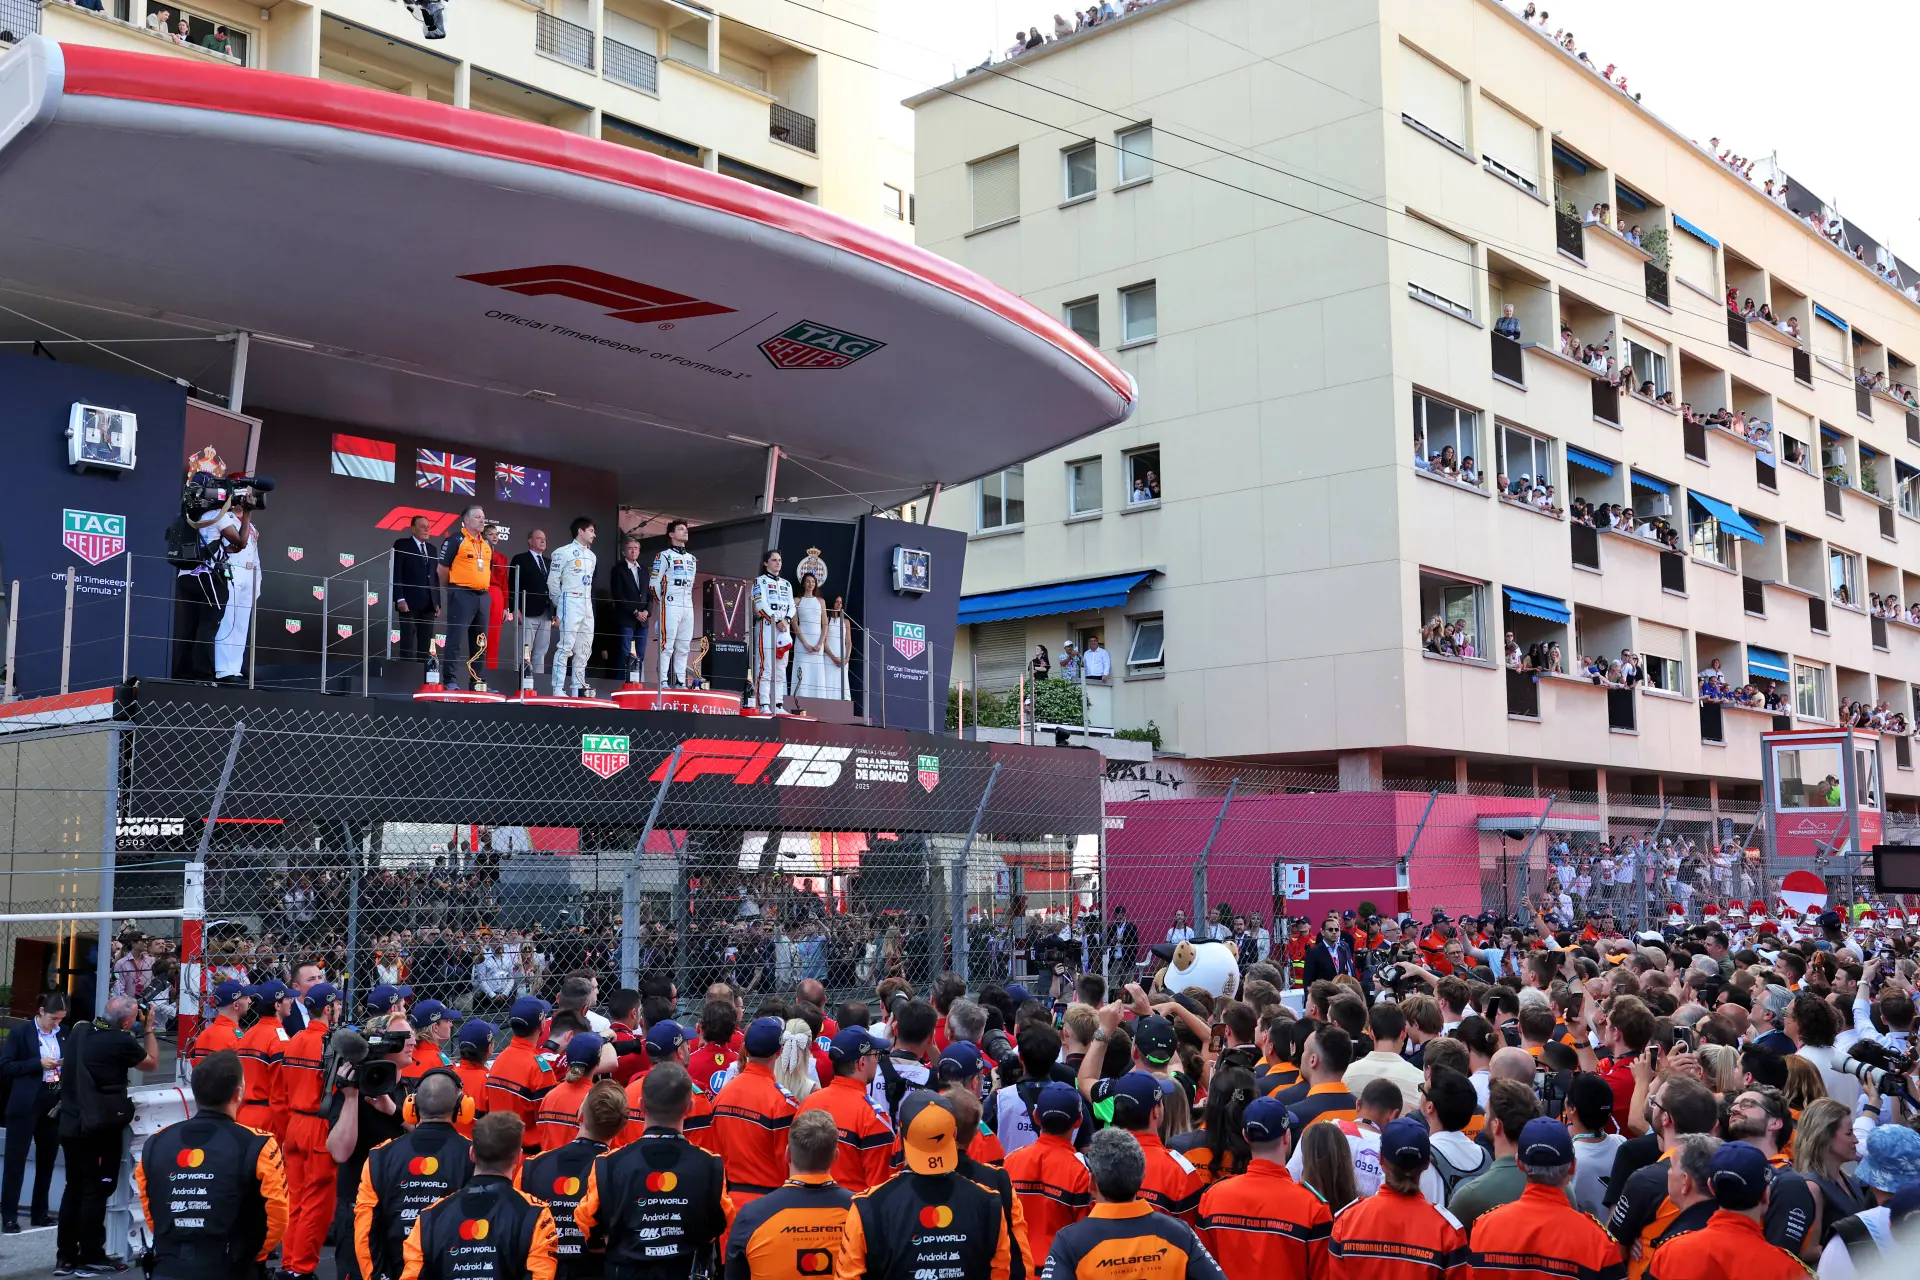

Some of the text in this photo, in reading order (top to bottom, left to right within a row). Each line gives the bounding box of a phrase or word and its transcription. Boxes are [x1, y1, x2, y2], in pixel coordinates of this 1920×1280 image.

[484, 309, 544, 329] Official
[550, 325, 648, 356] Timekeeper
[650, 351, 673, 361] of
[667, 355, 738, 377] Formula
[797, 326, 870, 355] TAG
[768, 340, 848, 366] HEUER
[68, 512, 120, 535] TAG
[66, 533, 122, 562] HEUER
[76, 584, 112, 595] Formula
[896, 624, 922, 638] TAG
[894, 638, 924, 657] HEUER
[903, 666, 928, 675] Timekeepe
[692, 702, 700, 713] &
[702, 705, 739, 715] CHANDO
[586, 737, 625, 751] TAG
[585, 753, 627, 775] HEUER
[856, 757, 909, 772] GRAND PRIX
[919, 757, 939, 771] TAG
[856, 769, 908, 783] DE MONACO
[918, 771, 939, 790] HEUER
[927, 1156, 944, 1169] 81
[171, 1187, 196, 1195] Android
[403, 1195, 430, 1203] Android
[642, 1213, 669, 1222] Android
[780, 1225, 843, 1234] McLaren
[1267, 1220, 1294, 1232] MONACO
[923, 1234, 967, 1243] DP WORLD
[916, 1251, 948, 1262] Android
[1343, 1242, 1383, 1253] AUTOMOBILE
[1383, 1244, 1400, 1254] CLUB
[1406, 1247, 1434, 1260] MONACO
[1096, 1253, 1161, 1268] McLaren
[1484, 1253, 1524, 1265] AUTOMOBILE
[453, 1262, 482, 1271] Android
